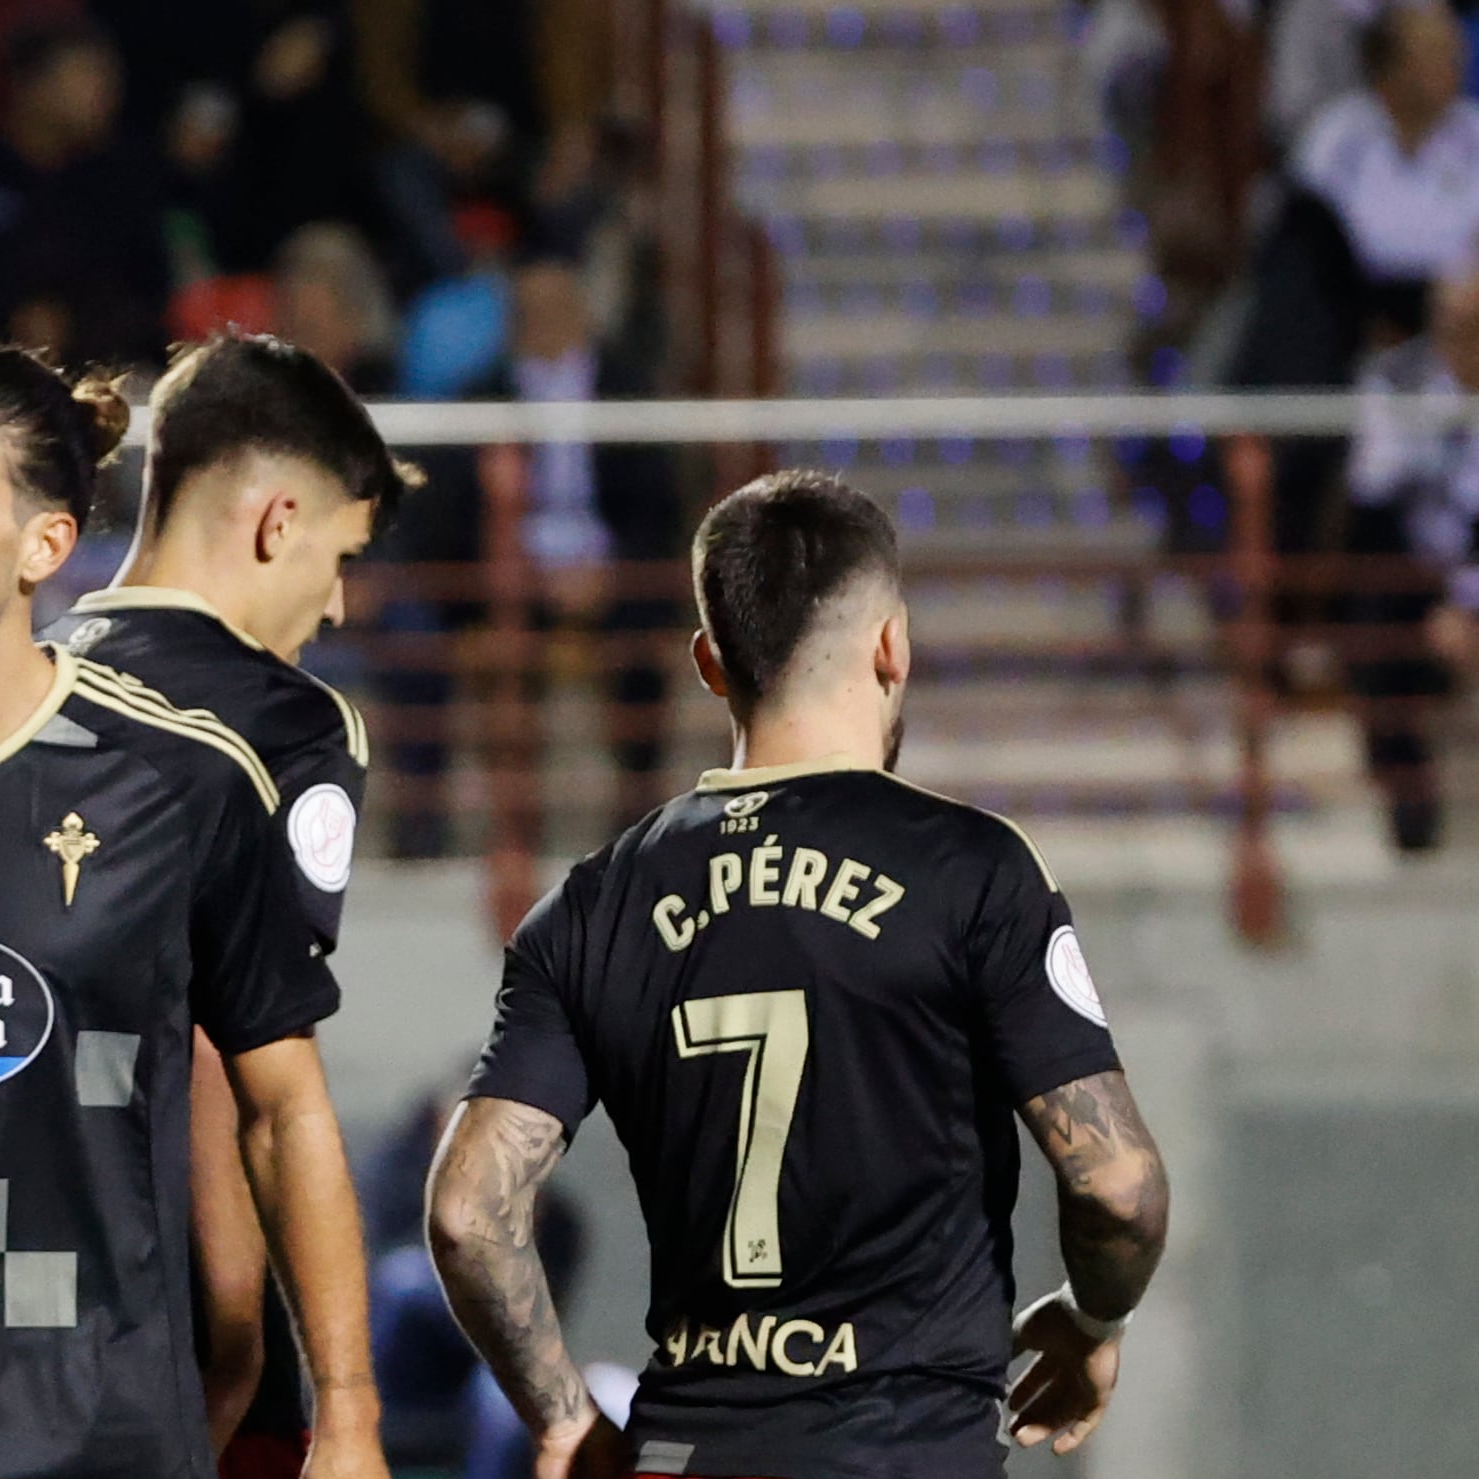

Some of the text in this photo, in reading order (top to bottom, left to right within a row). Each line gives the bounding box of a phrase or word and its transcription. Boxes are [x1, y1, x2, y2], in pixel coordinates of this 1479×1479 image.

[719, 816, 760, 835] 1923
[652, 833, 906, 953] C. PÉREZ
[670, 988, 810, 1289] 7
